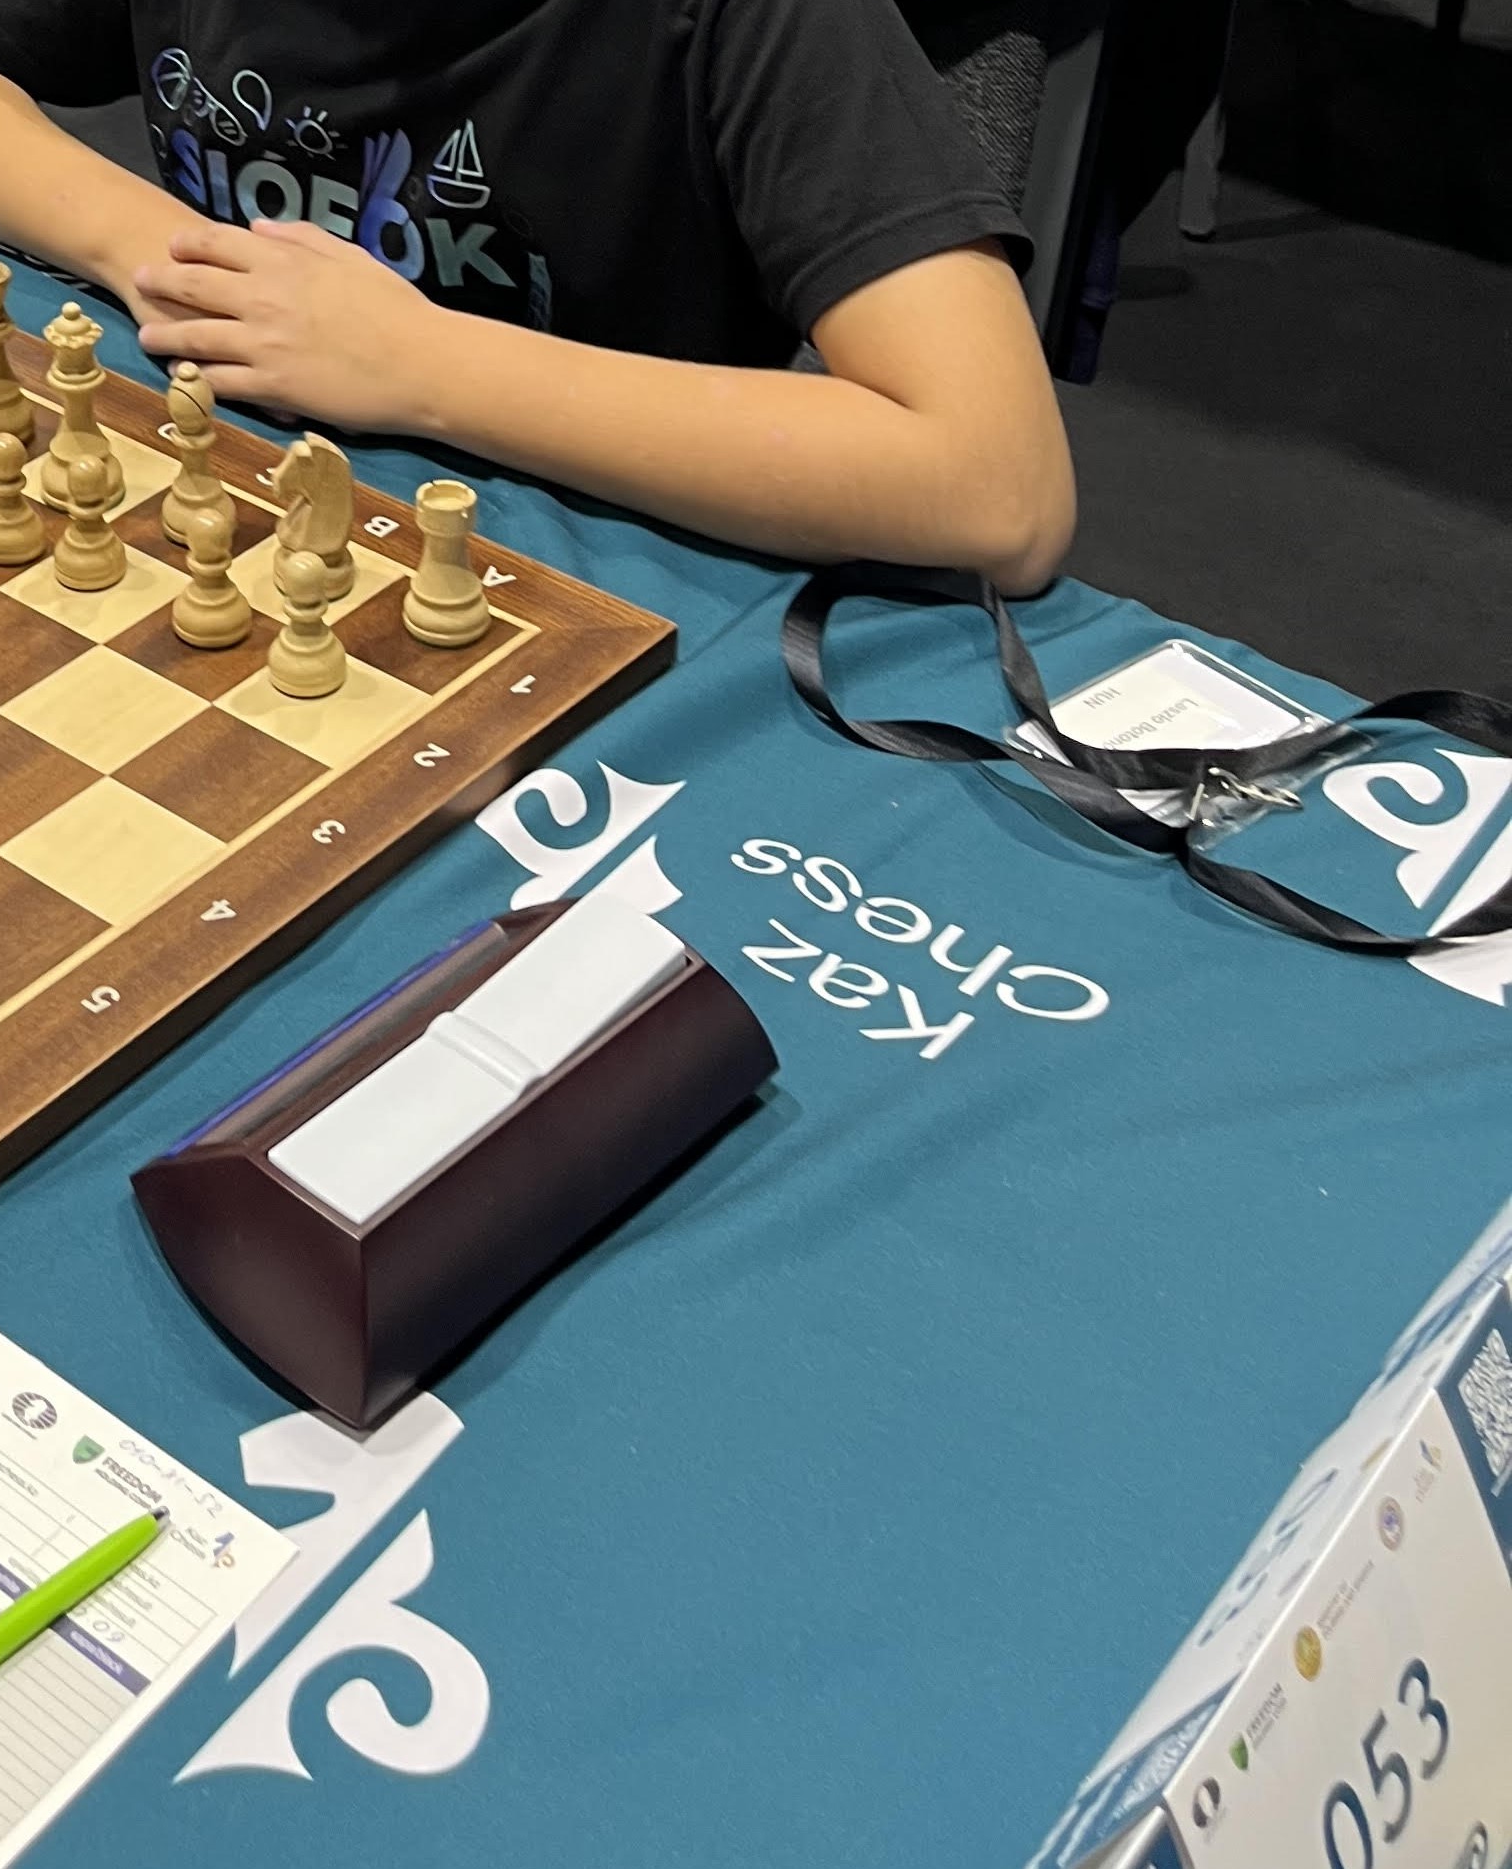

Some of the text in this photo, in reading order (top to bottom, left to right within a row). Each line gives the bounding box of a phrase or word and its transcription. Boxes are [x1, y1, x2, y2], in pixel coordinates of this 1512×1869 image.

[363, 514, 400, 539] B
[481, 565, 518, 588] A
[509, 674, 540, 697] 1
[1083, 686, 1121, 709] HUN
[1102, 721, 1159, 750] Boton
[413, 742, 451, 769] 2
[311, 818, 347, 845] 3
[199, 897, 237, 923] 4
[730, 836, 1111, 1022] Chess
[80, 984, 122, 1017] 5
[739, 917, 977, 1061] Kaz
[100, 1456, 163, 1504] FREEDOM
[1322, 1656, 1450, 1869] 053
